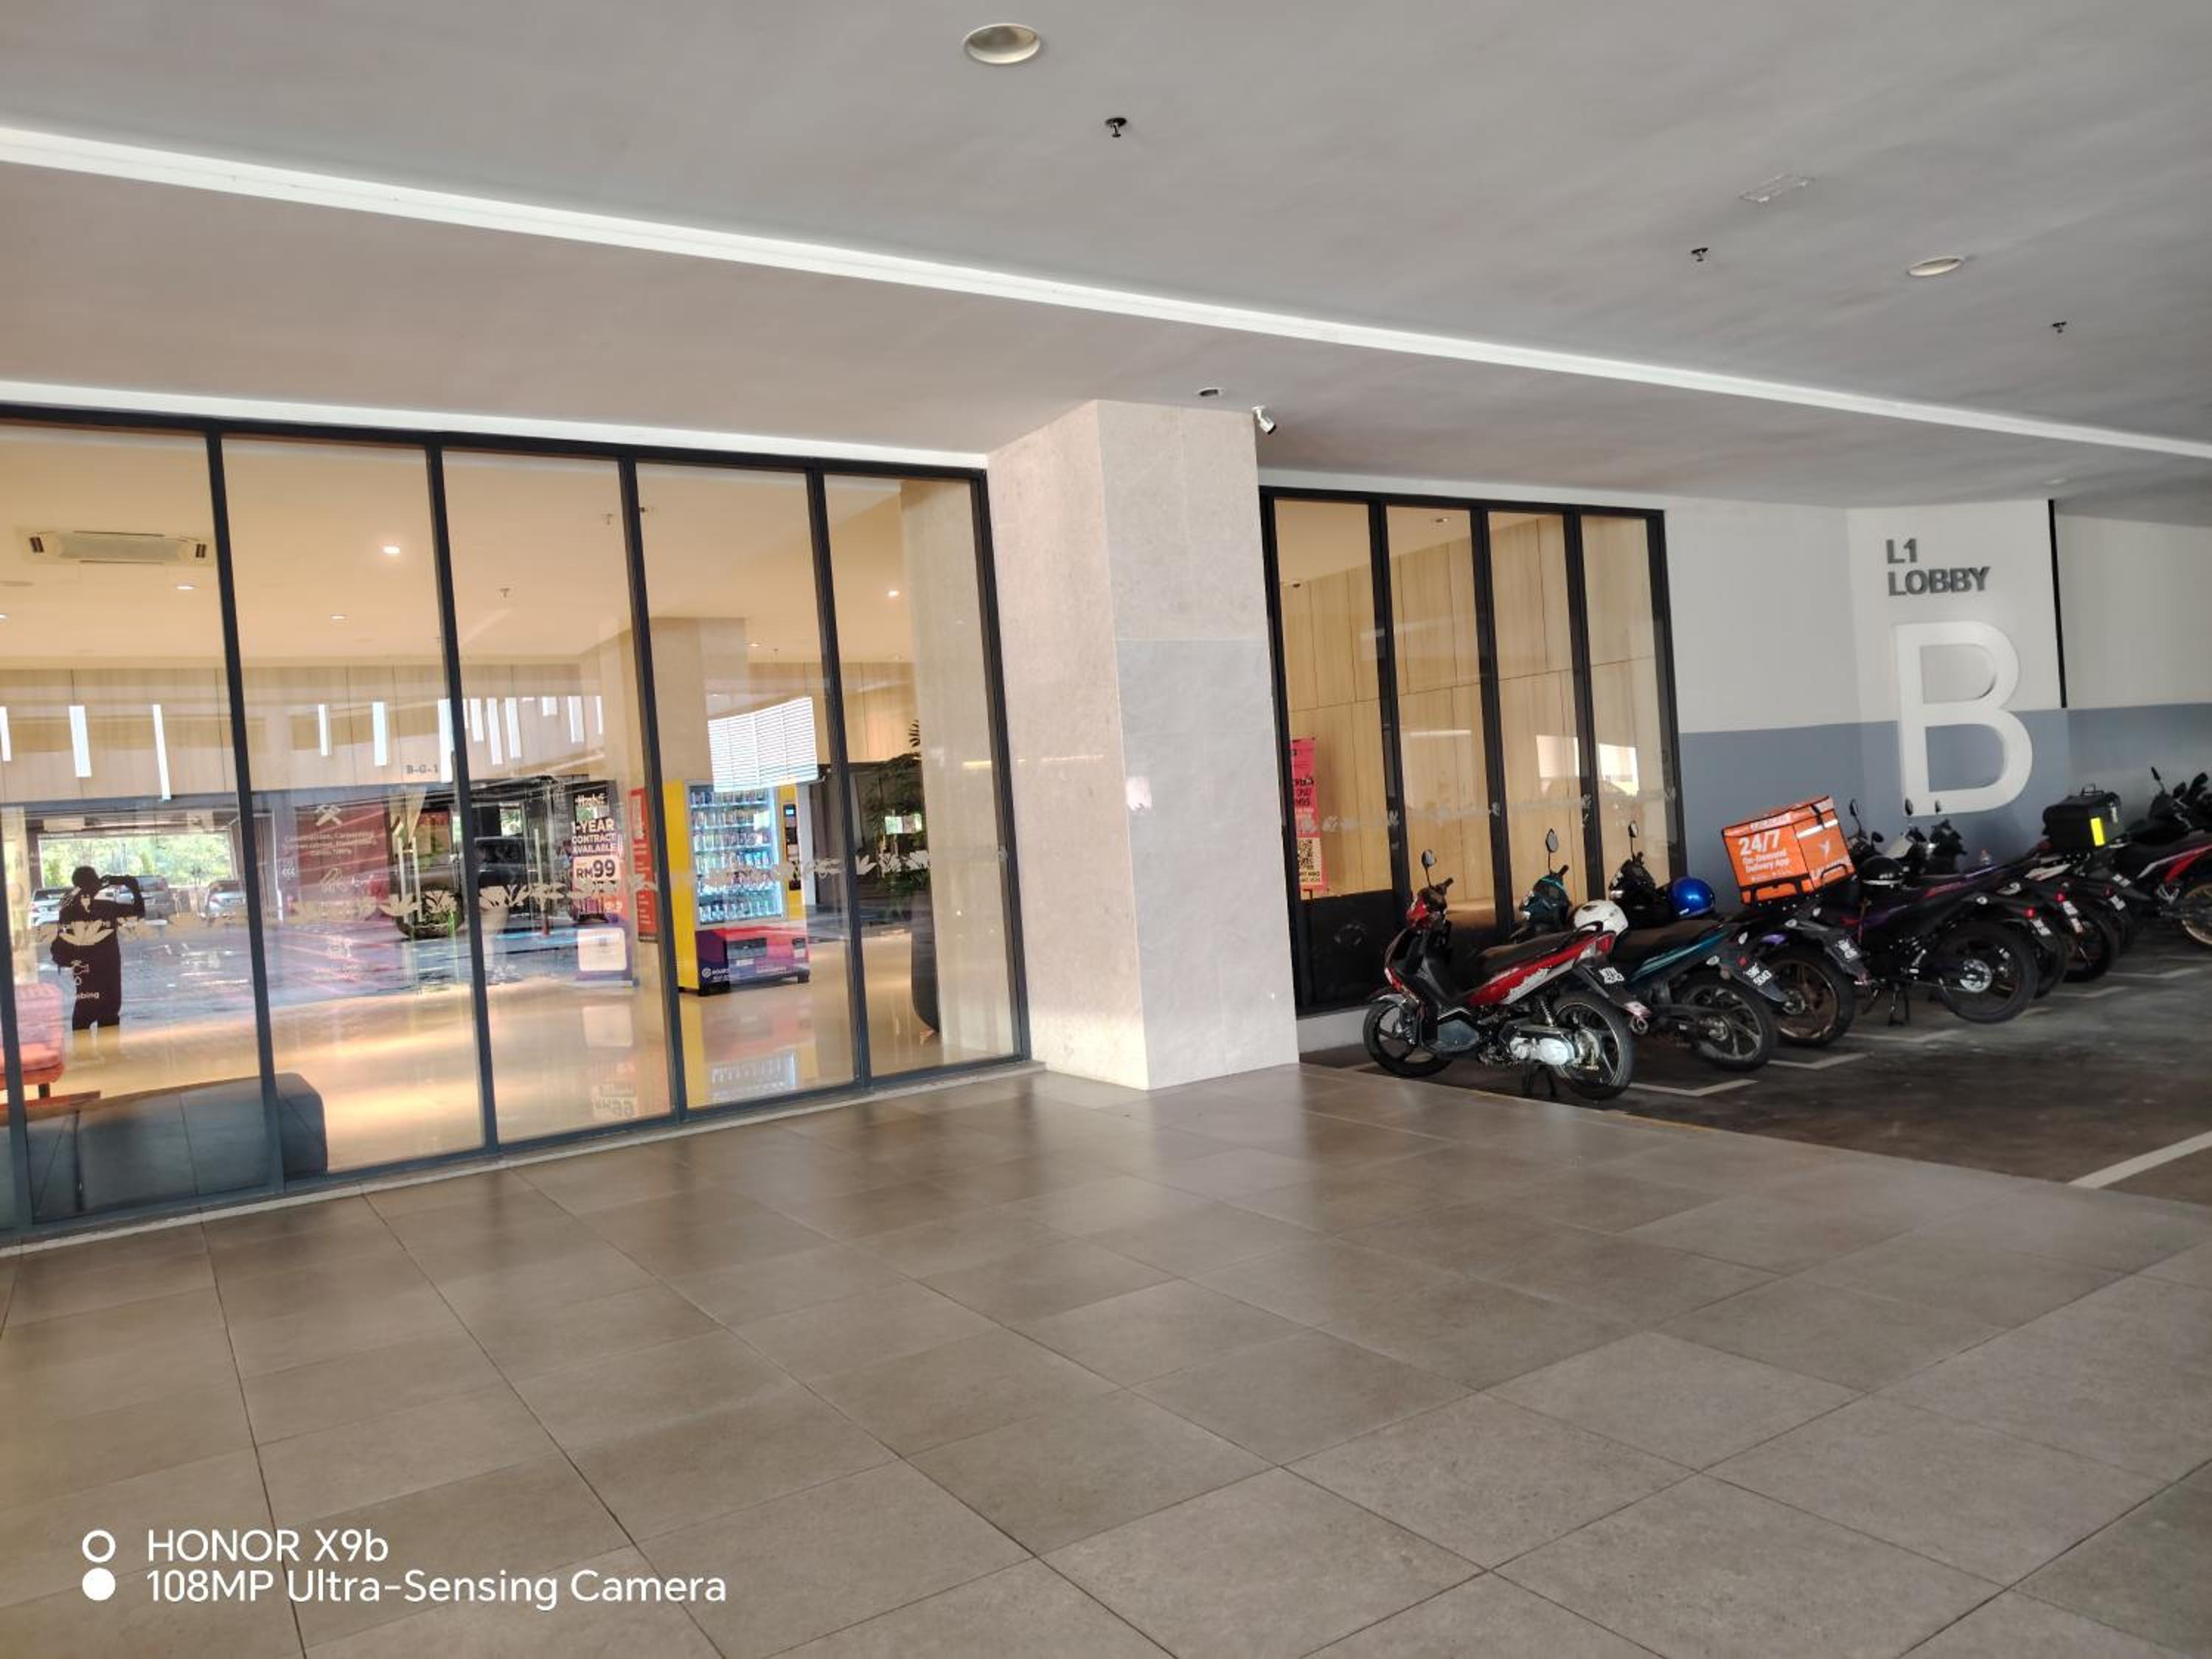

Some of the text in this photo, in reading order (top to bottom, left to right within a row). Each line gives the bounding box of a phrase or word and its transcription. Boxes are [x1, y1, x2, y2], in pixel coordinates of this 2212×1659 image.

[1886, 538, 1918, 564] L1
[1888, 566, 1991, 597] LOBBY
[1893, 621, 2033, 816] B
[571, 818, 614, 834] 1-YEAR
[571, 833, 617, 844] CONTRACT
[572, 843, 616, 854] AVAILABLE
[1739, 829, 1781, 856] 24/7
[576, 859, 616, 879] RM99
